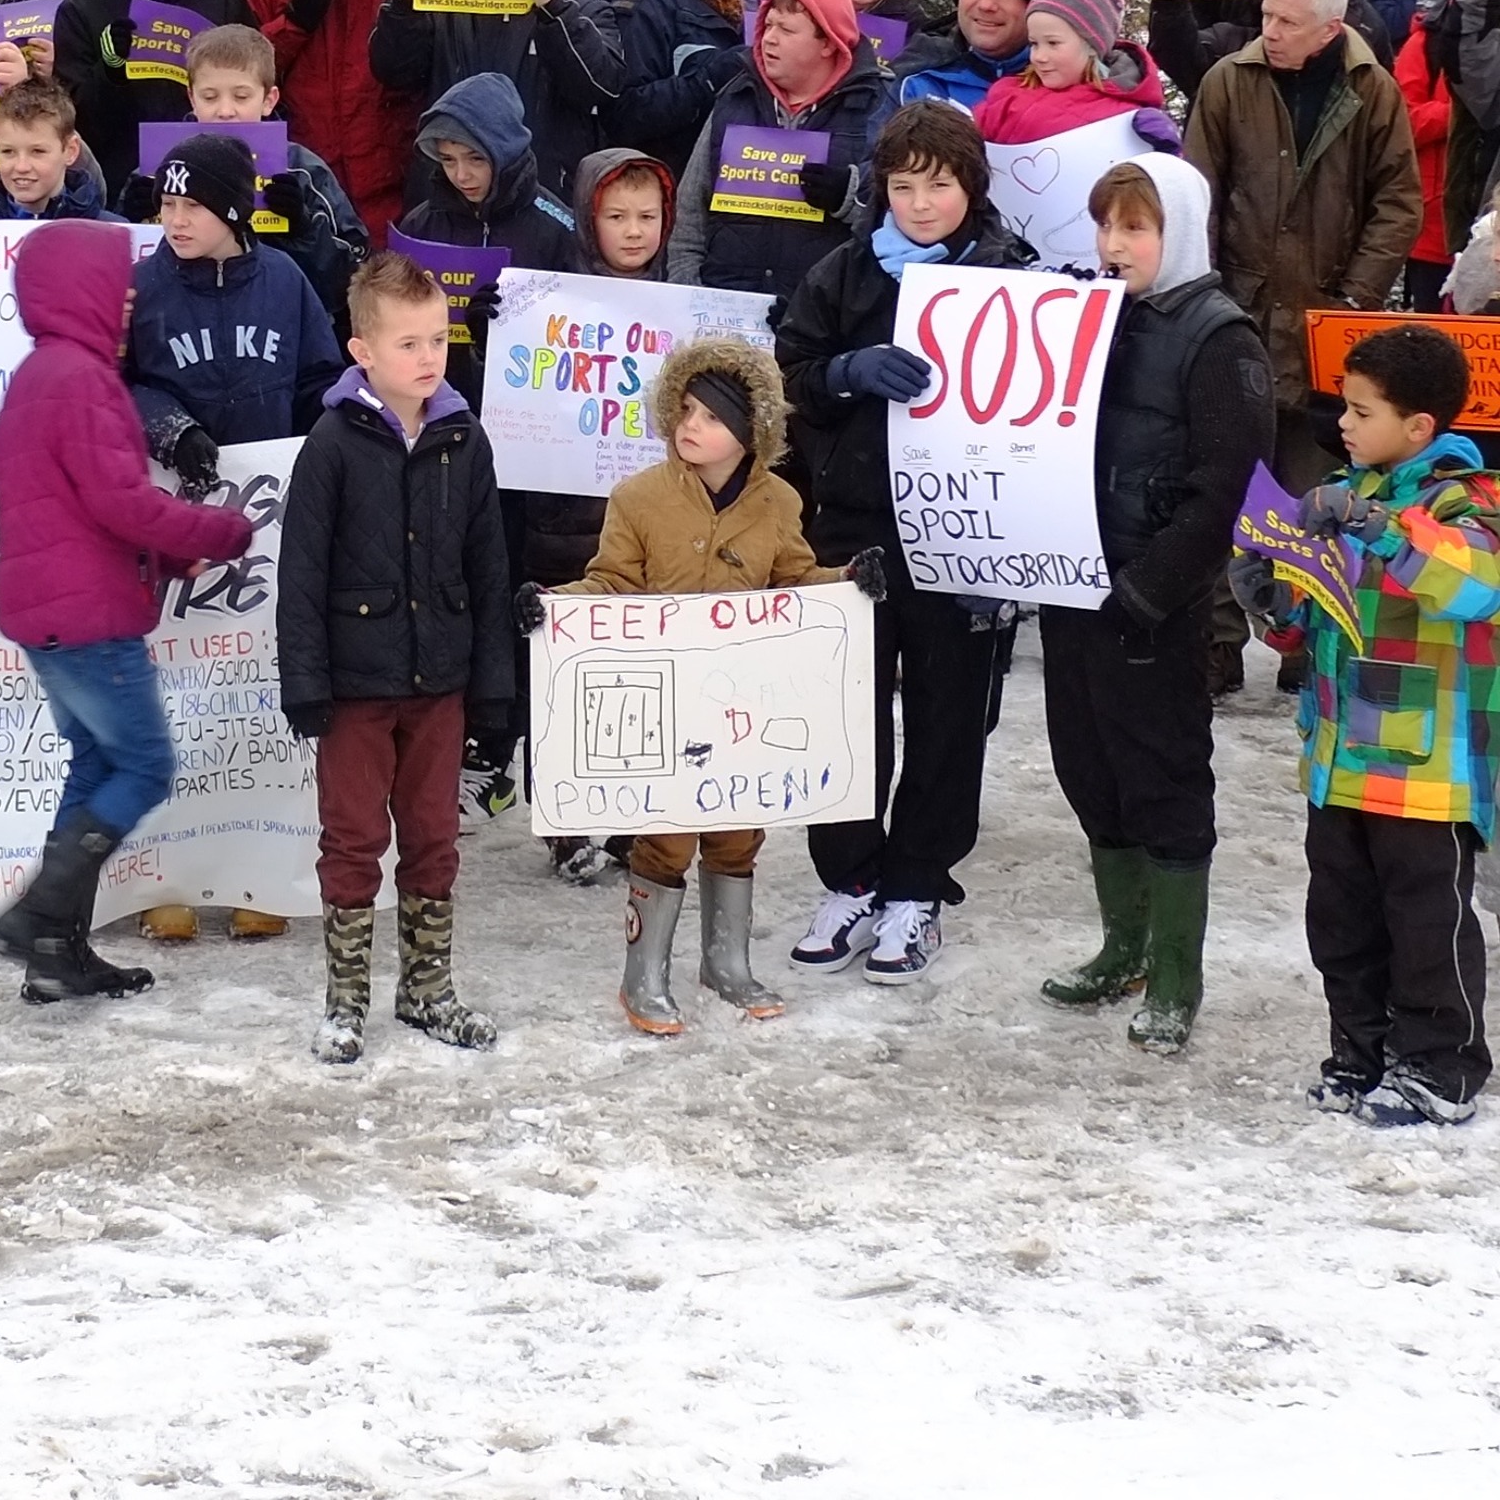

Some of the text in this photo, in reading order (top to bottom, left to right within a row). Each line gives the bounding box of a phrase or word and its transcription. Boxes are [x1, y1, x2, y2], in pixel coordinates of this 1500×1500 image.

[5, 24, 53, 39] Centre
[16, 15, 41, 27] our
[152, 21, 191, 40] Save
[131, 34, 182, 54] Sports
[720, 164, 766, 182] Sports
[741, 146, 806, 165] Save our
[441, 273, 476, 287] our
[545, 313, 673, 355] KEEP OUR
[693, 312, 744, 328] TO LINE
[168, 325, 281, 369] NIKE
[908, 286, 1111, 427] SOS!
[504, 344, 641, 397] SPORTS
[903, 445, 932, 462] Save
[894, 470, 1006, 503] DON'T
[898, 508, 1006, 545] SPOIL
[1239, 515, 1314, 558] Sports
[909, 550, 1111, 590] STOCKSBRIDGE
[551, 593, 792, 643] KEEP OUR
[554, 781, 666, 820] POOL
[107, 847, 163, 888] HERE!
